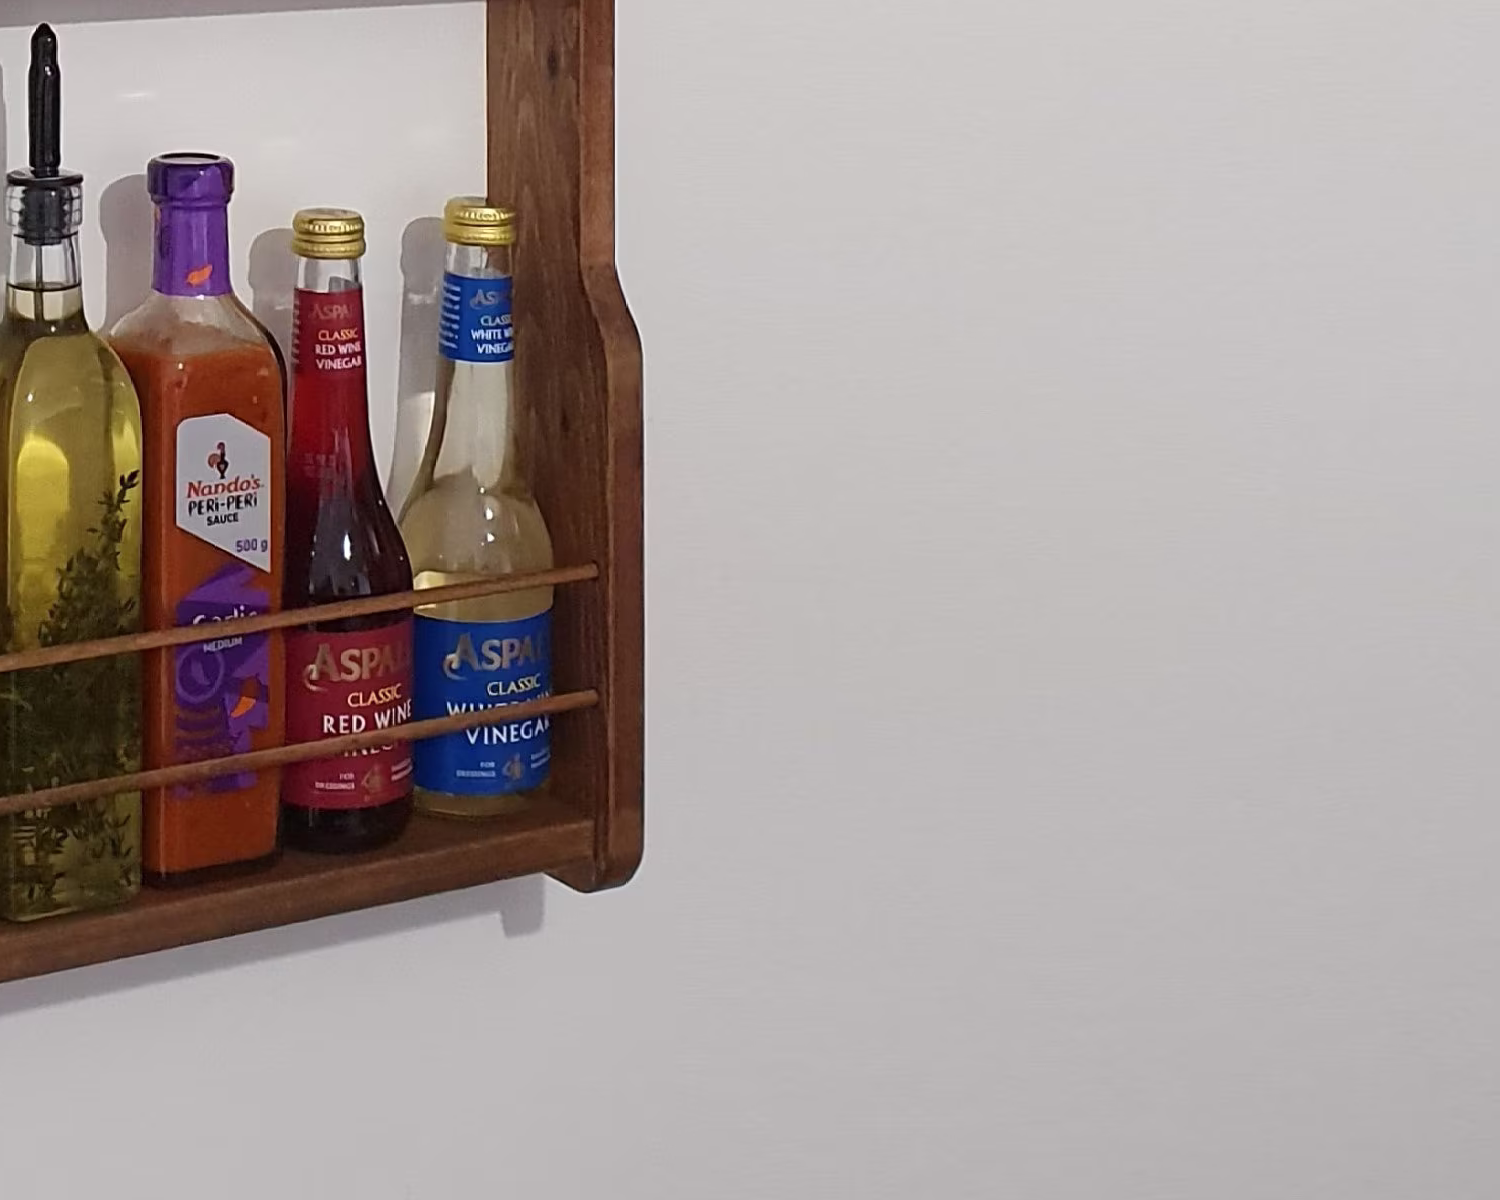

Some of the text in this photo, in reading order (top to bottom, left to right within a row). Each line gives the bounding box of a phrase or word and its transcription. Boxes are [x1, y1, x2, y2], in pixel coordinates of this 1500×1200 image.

[318, 328, 359, 341] CLASSIC
[315, 341, 361, 355] RED WINE
[187, 473, 261, 498] Nando's
[207, 512, 239, 526] SAUCE
[236, 538, 268, 553] 500 g
[487, 673, 541, 696] CLASSIC
[347, 683, 402, 708] CLASSIC
[323, 698, 412, 734] RED WINE
